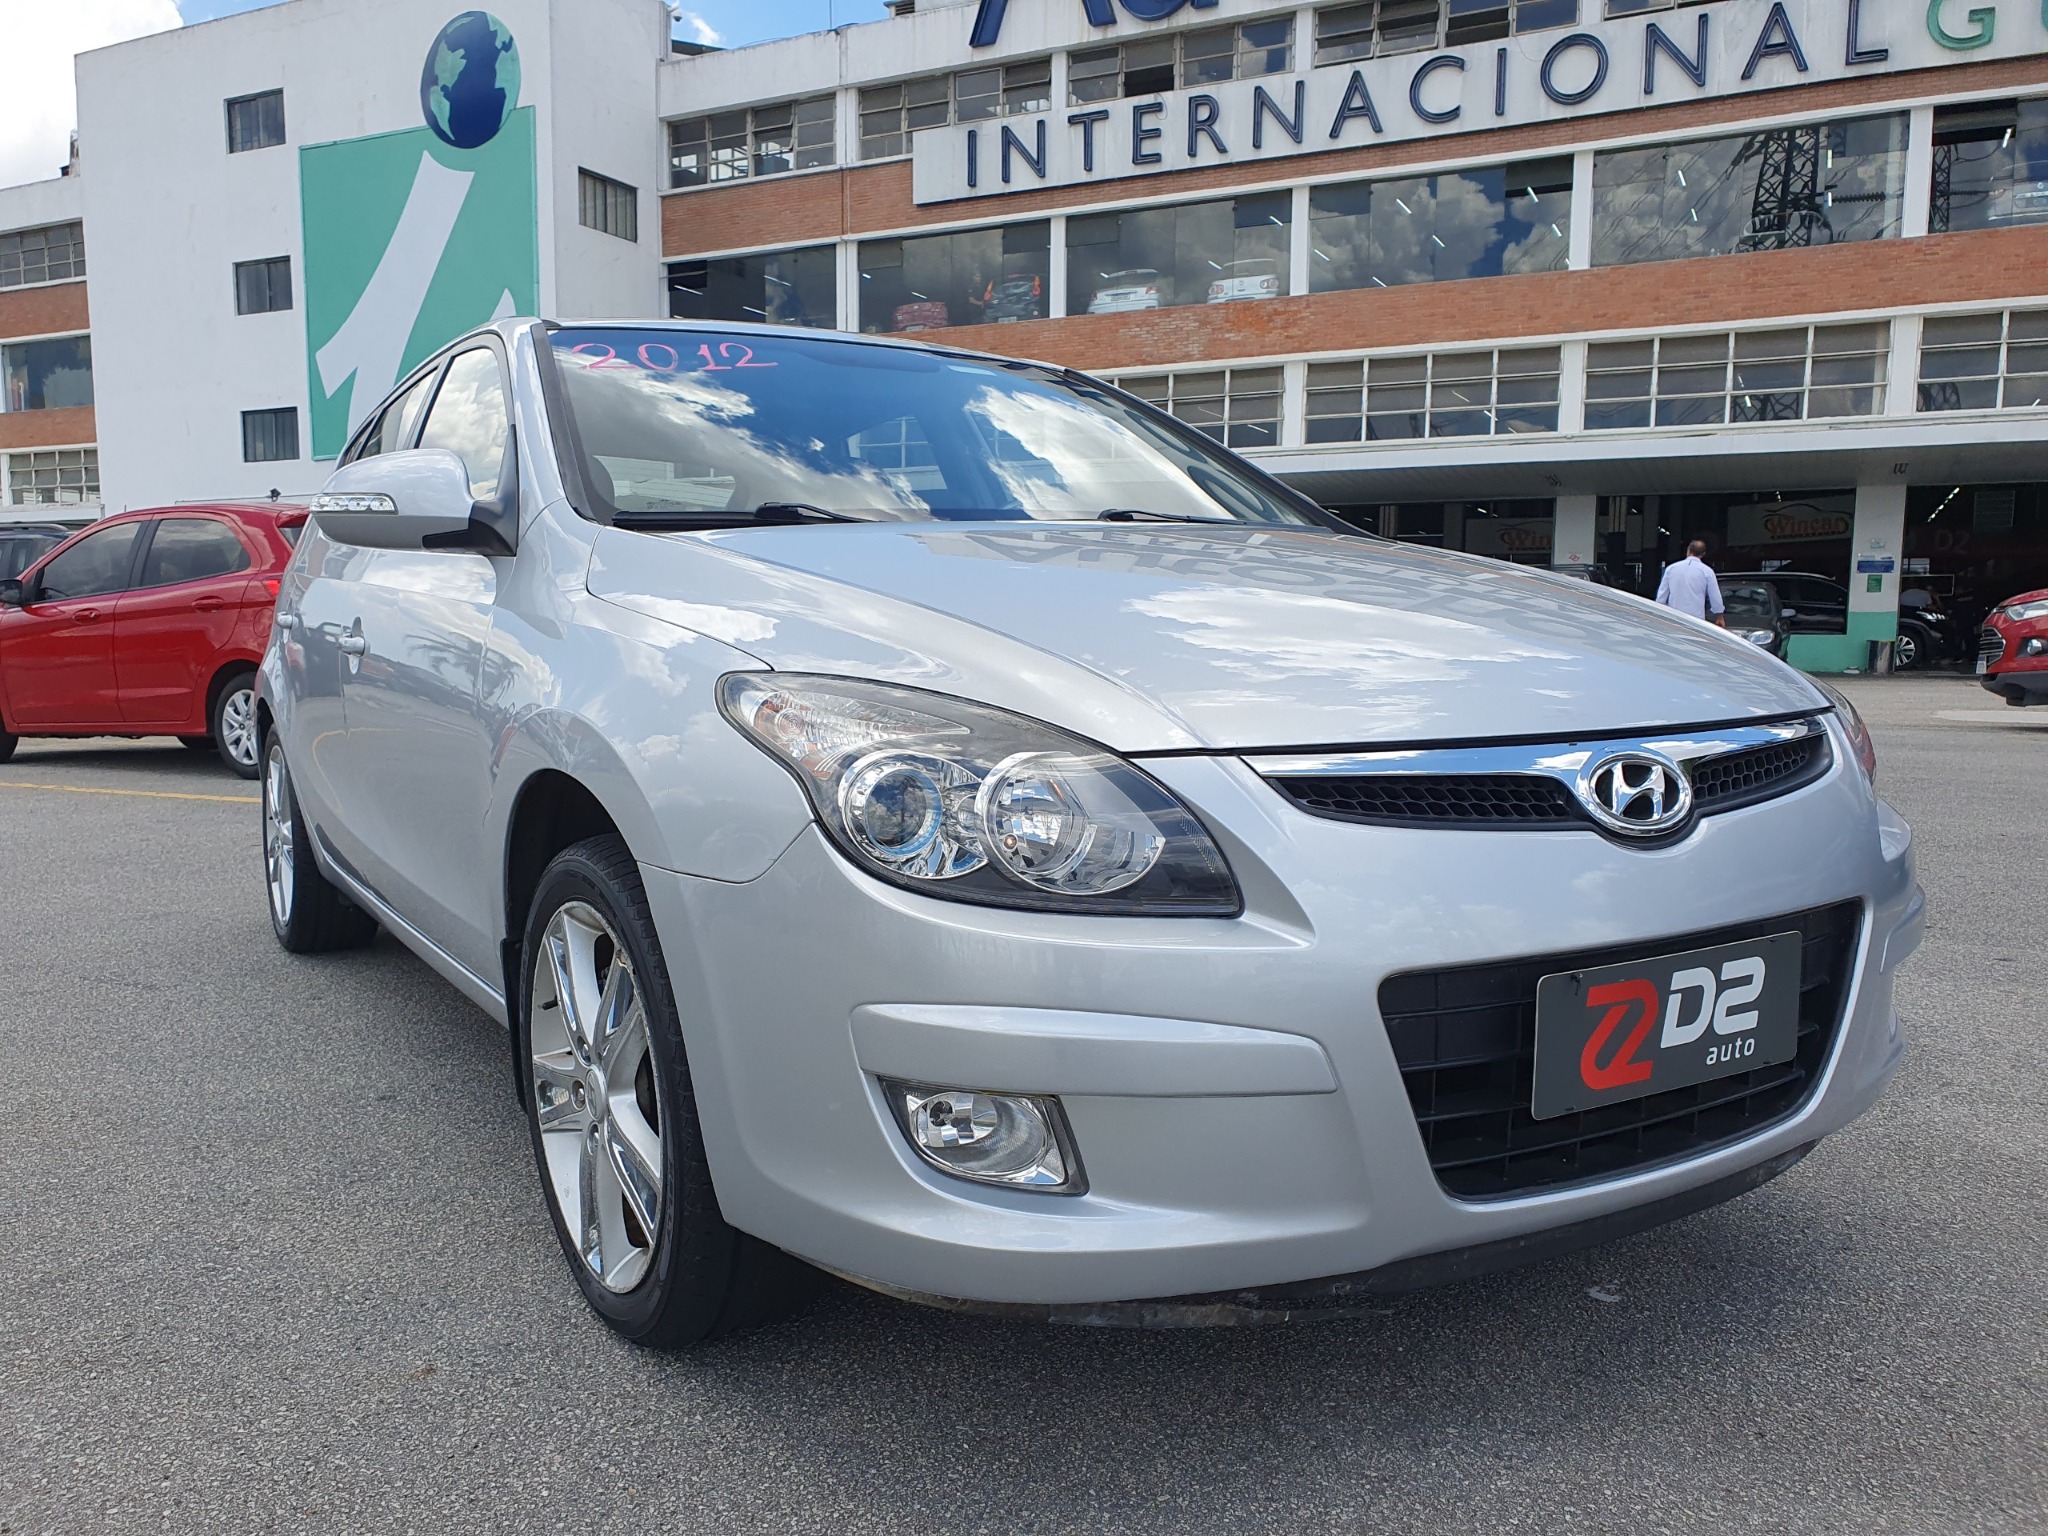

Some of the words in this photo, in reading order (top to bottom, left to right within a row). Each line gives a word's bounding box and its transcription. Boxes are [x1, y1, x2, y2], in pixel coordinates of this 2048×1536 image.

[967, 0, 1889, 188] INTERNACIONAL
[572, 343, 778, 371] 2012
[1660, 956, 1766, 1049] D2
[1706, 1037, 1755, 1065] auto
